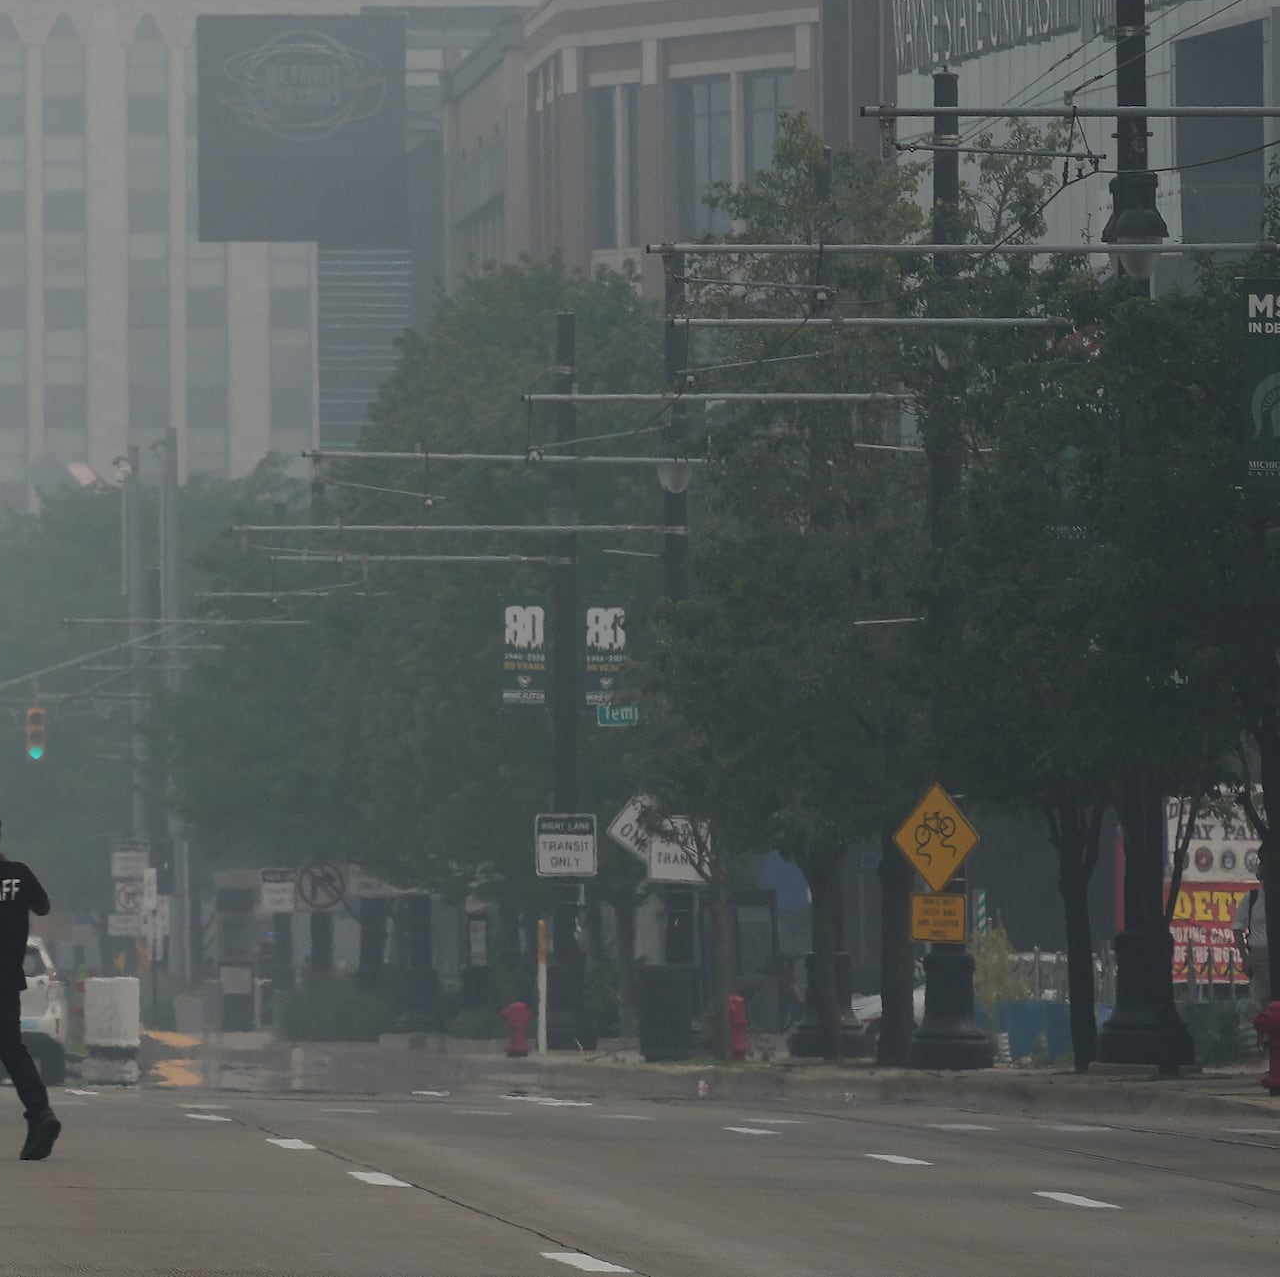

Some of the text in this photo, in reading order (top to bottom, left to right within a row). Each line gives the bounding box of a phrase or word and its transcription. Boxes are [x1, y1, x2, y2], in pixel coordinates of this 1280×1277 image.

[1248, 322, 1262, 334] IN
[505, 606, 545, 649] 80
[541, 840, 589, 852] TRANSIT
[550, 856, 581, 868] ONLY
[1173, 945, 1187, 963] OF
